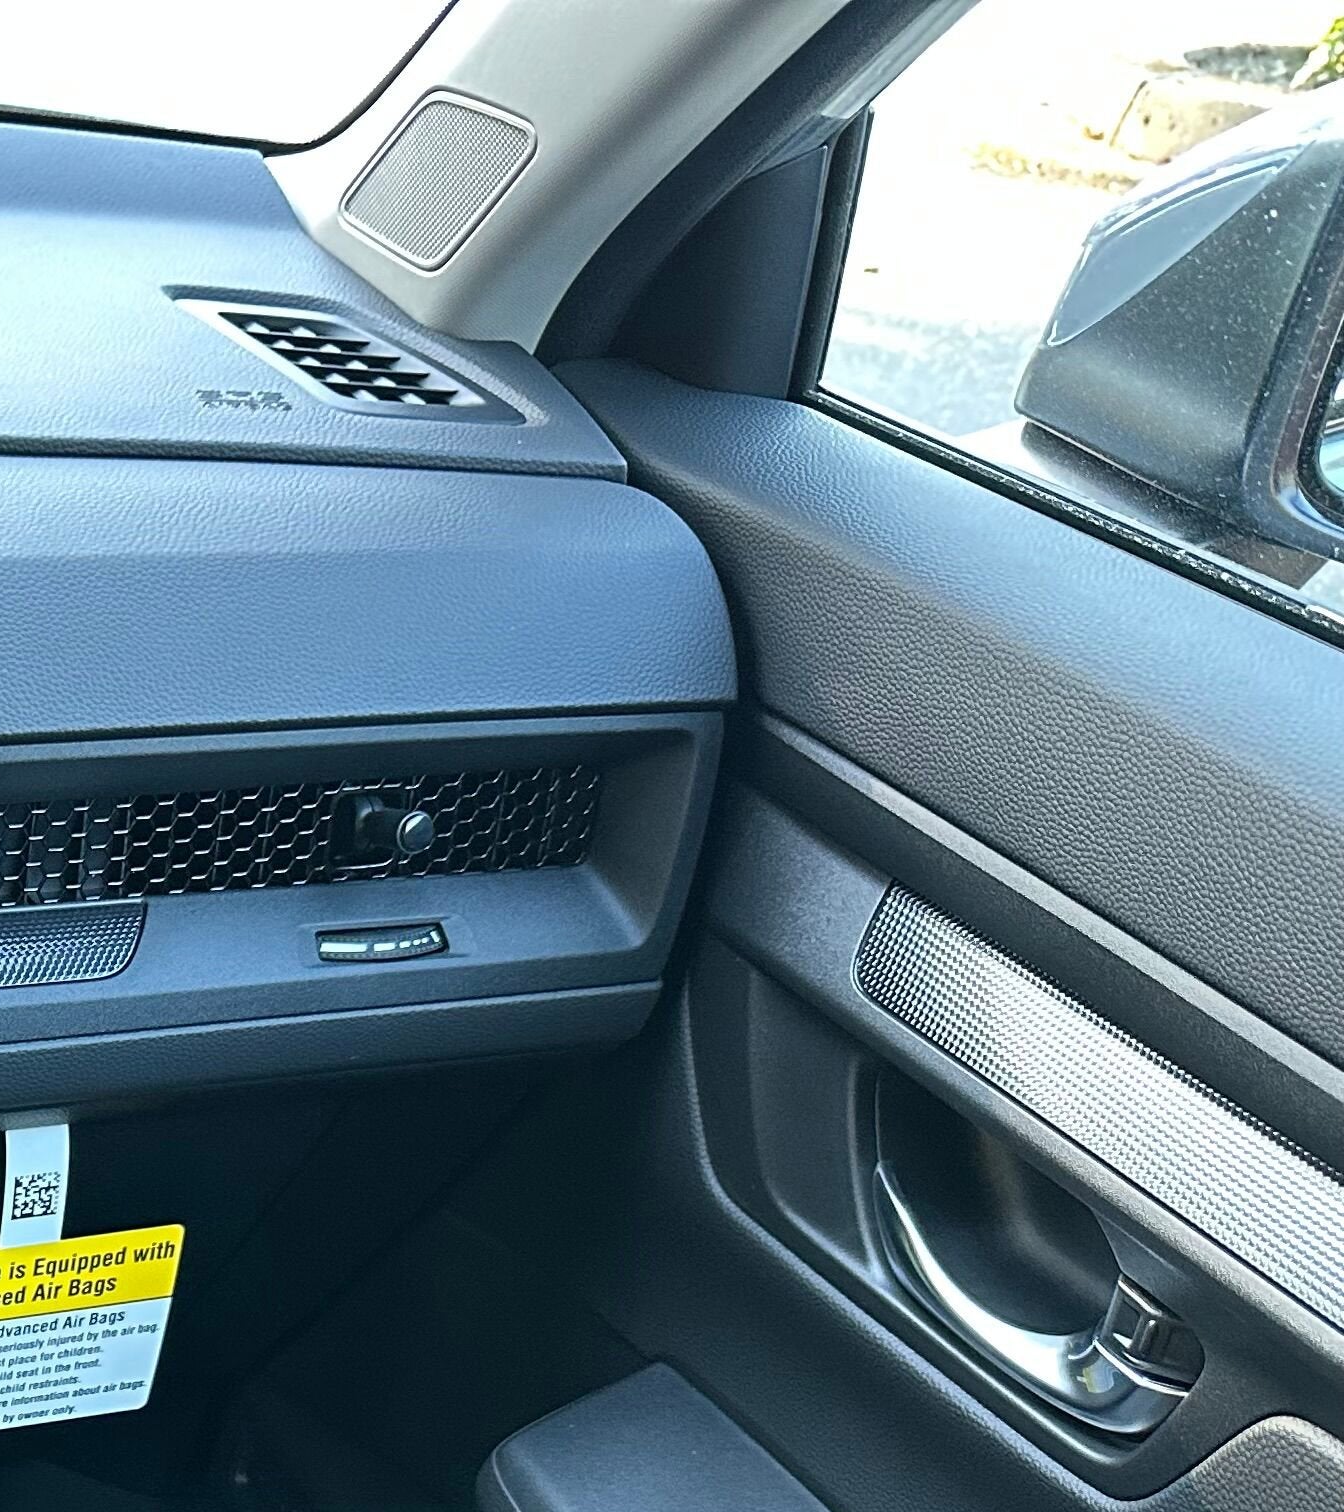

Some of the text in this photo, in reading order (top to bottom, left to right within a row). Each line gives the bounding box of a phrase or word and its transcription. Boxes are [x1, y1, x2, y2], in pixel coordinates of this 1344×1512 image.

[9, 1262, 27, 1280] is
[33, 1246, 127, 1278] Equipped
[134, 1240, 176, 1263] with
[32, 1282, 63, 1302] Air
[68, 1277, 117, 1297] Bags
[62, 1315, 86, 1330] Air
[88, 1311, 126, 1326] Bags
[47, 1332, 84, 1347] injured
[87, 1330, 99, 1342] by
[101, 1328, 118, 1339] the
[120, 1325, 136, 1336] air
[137, 1322, 159, 1334] bag.
[8, 1354, 37, 1368] place
[40, 1351, 55, 1361] for
[57, 1345, 104, 1359] children.
[16, 1367, 39, 1379] seat
[42, 1365, 52, 1375] in
[55, 1362, 71, 1372] the
[0, 1382, 25, 1394] child
[29, 1375, 82, 1390] restraints.
[11, 1388, 69, 1405] information
[72, 1384, 101, 1397] about
[102, 1382, 117, 1393] air
[2, 1413, 15, 1424] by
[17, 1410, 50, 1421] owner
